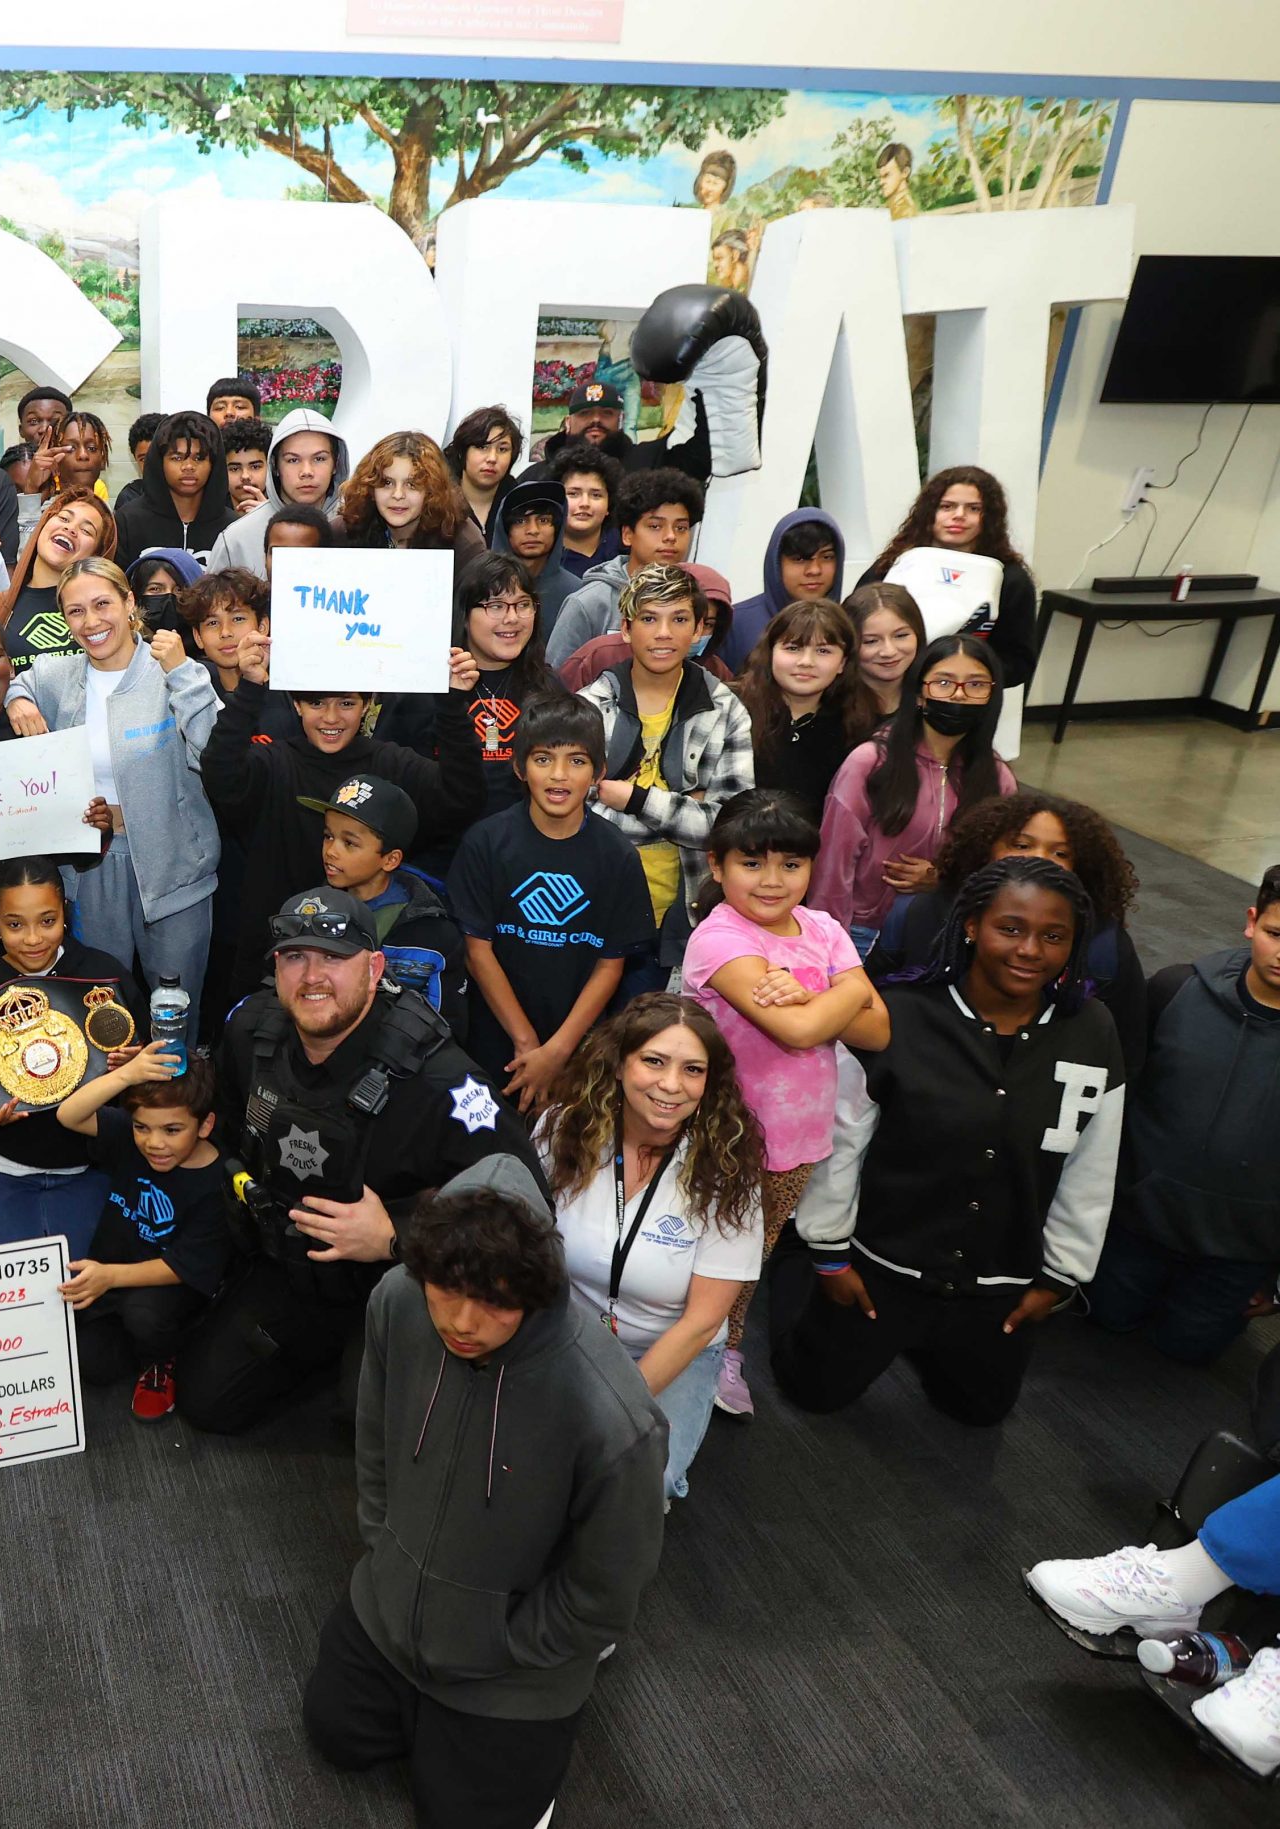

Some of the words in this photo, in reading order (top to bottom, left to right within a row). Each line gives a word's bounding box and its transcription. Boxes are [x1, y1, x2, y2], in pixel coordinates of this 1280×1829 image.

[293, 585, 370, 616] THANK
[345, 622, 382, 641] you
[517, 926, 525, 939] &
[527, 929, 557, 943] GIRLS
[460, 1087, 484, 1110] FRESNO
[1040, 1060, 1109, 1154] P
[468, 1098, 493, 1123] POLICE
[288, 1138, 318, 1156] FRESNO
[286, 1153, 318, 1172] POLICE
[10, 1399, 72, 1426] Estrada
